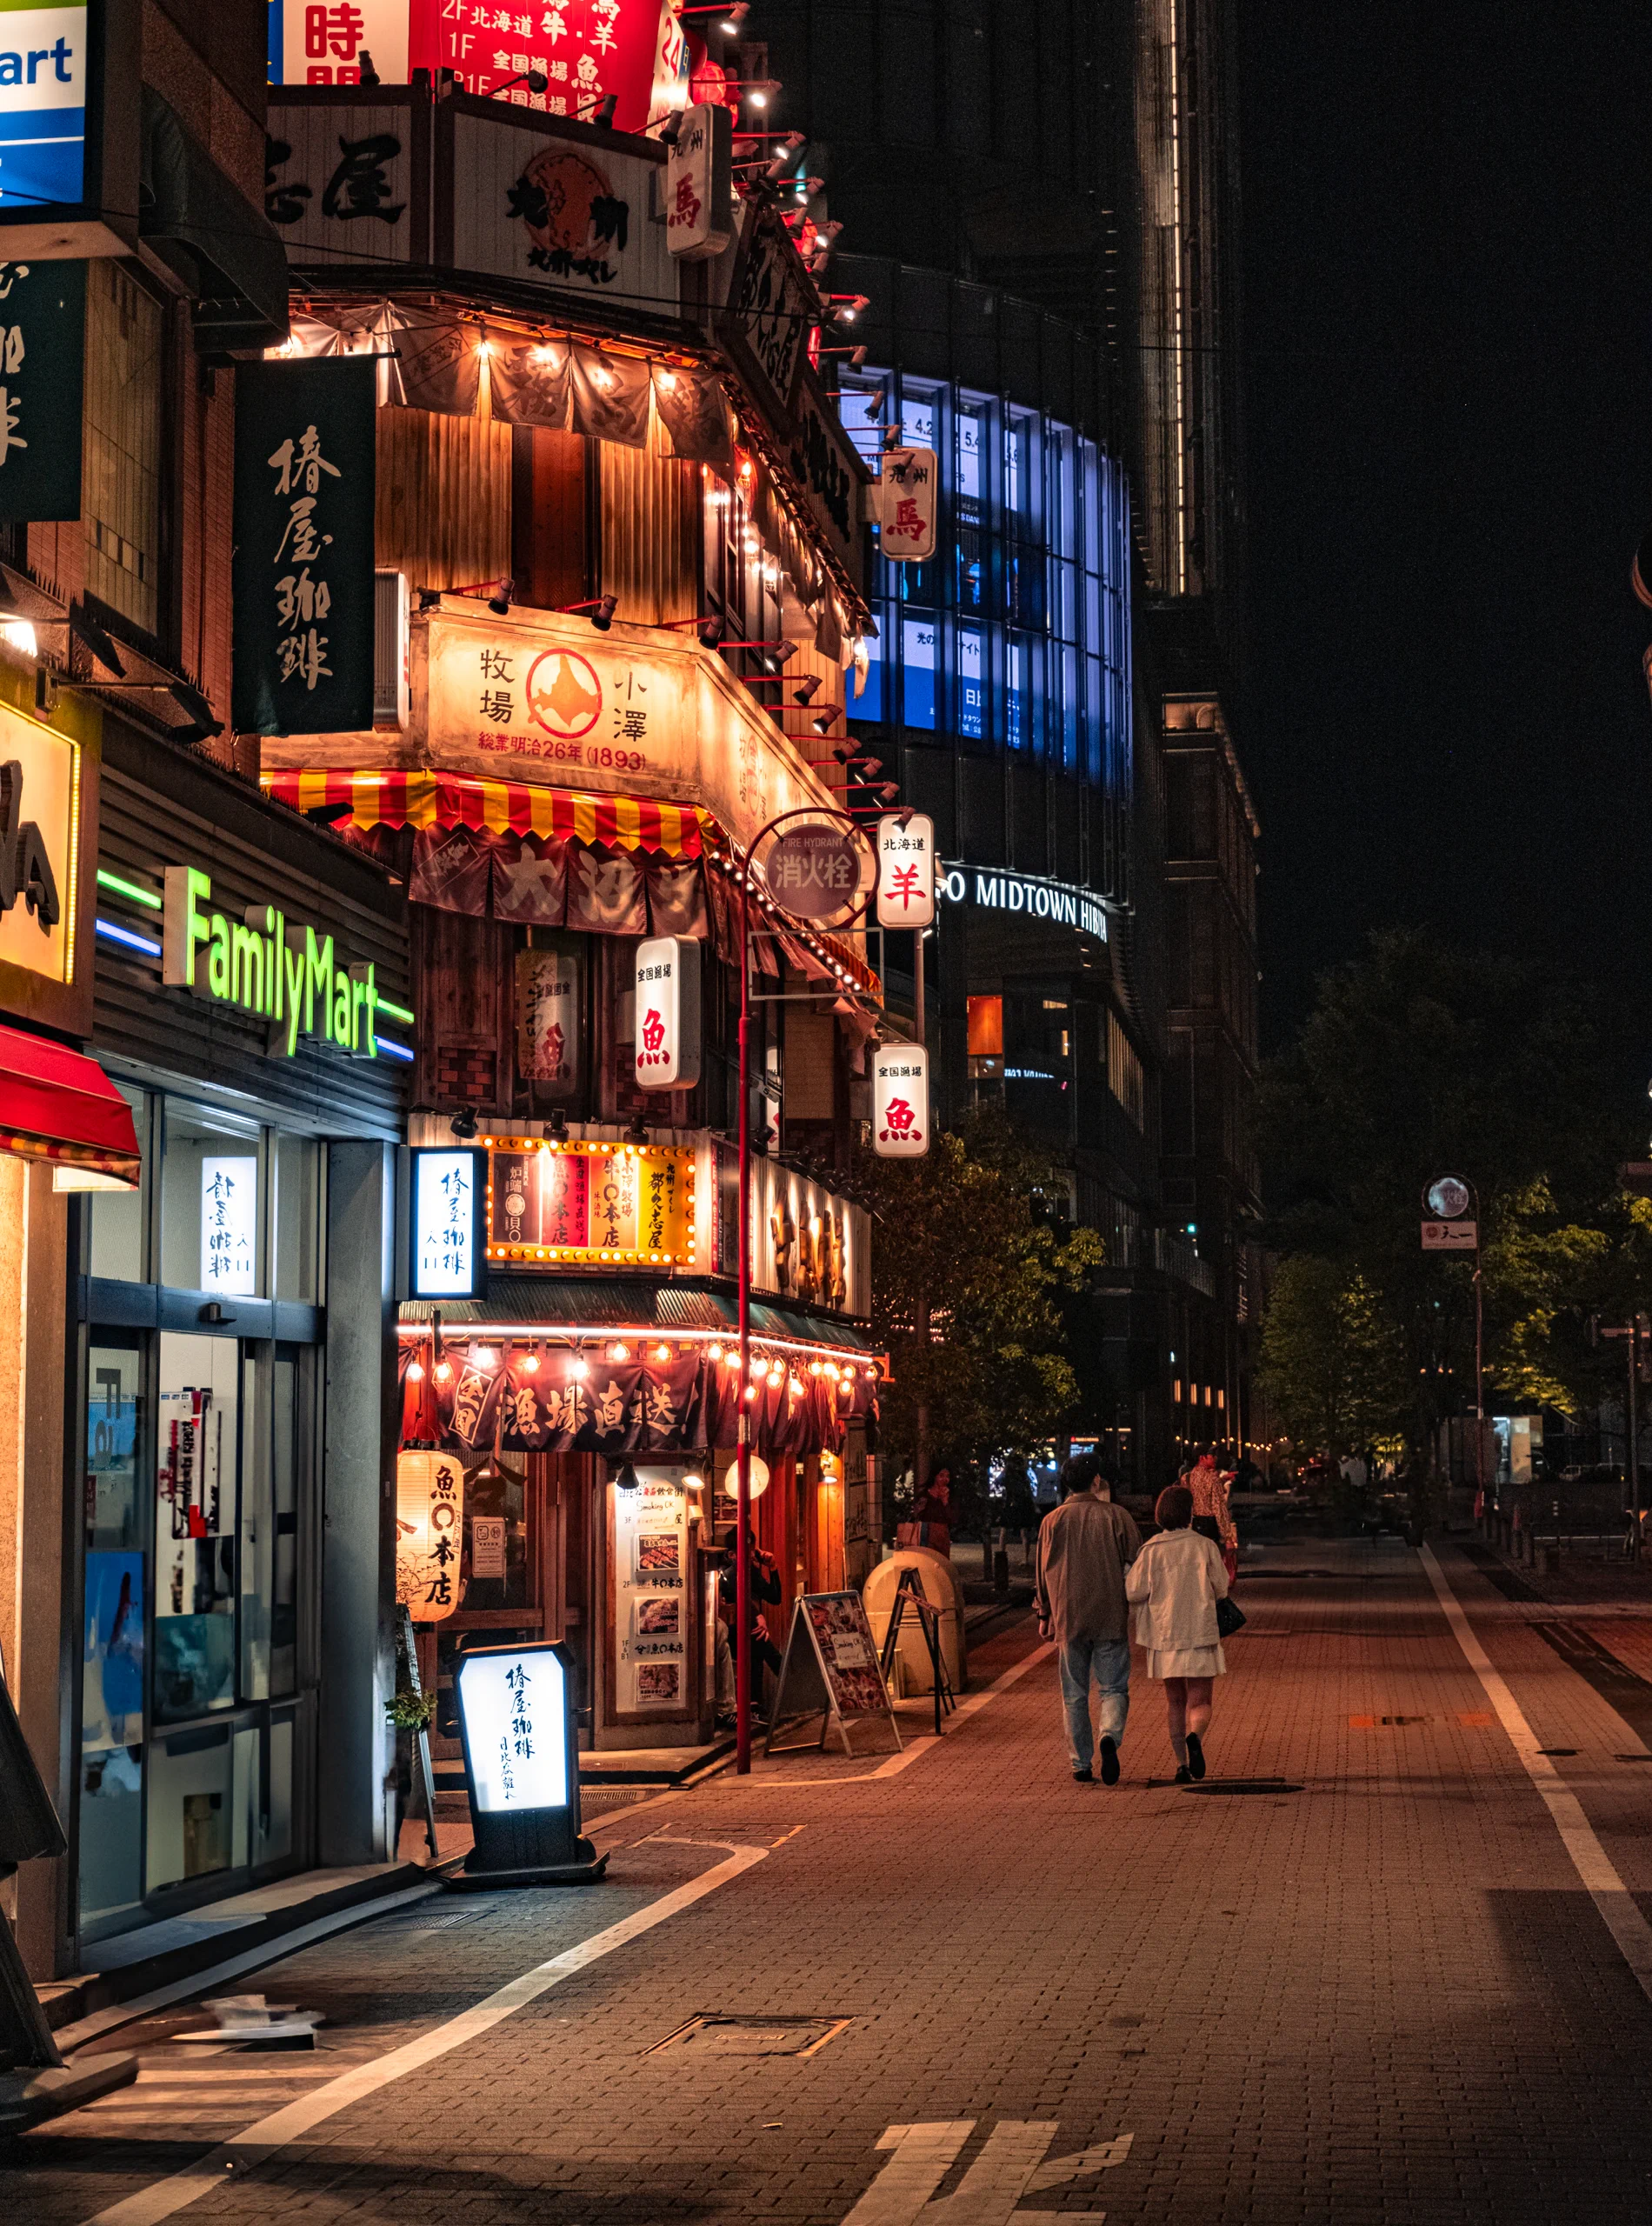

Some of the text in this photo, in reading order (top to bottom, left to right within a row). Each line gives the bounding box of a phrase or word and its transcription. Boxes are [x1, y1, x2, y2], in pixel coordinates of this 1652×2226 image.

[470, 6, 533, 38] 北海道
[0, 37, 73, 86] art
[449, 32, 603, 92] 1F 全国漁場 魚
[670, 131, 703, 159] 九州
[669, 172, 702, 229] 馬
[886, 498, 927, 542] 馬
[268, 424, 342, 690] 椿屋珈琲
[480, 649, 516, 724] 牧場
[614, 671, 648, 742] 小澤
[587, 746, 647, 771] (1893)
[783, 837, 843, 848] FIRE HYDRANT
[883, 838, 925, 851] 北海道
[776, 853, 852, 889] 消火栓
[884, 863, 926, 911] 羊
[976, 875, 1076, 925] MIDTOWN
[1081, 900, 1108, 943] HIBIYA
[186, 867, 378, 1058] FamilyMart
[637, 963, 671, 983] 全国漁場
[637, 1008, 670, 1069] 魚
[878, 1066, 922, 1077] 全国漁場
[879, 1096, 923, 1143] 魚
[510, 1166, 522, 1193] 炉端
[441, 1168, 470, 1276] 椿屋珈琲
[636, 1500, 663, 1512] Smoking
[505, 1663, 535, 1759] 椿屋珈琲
